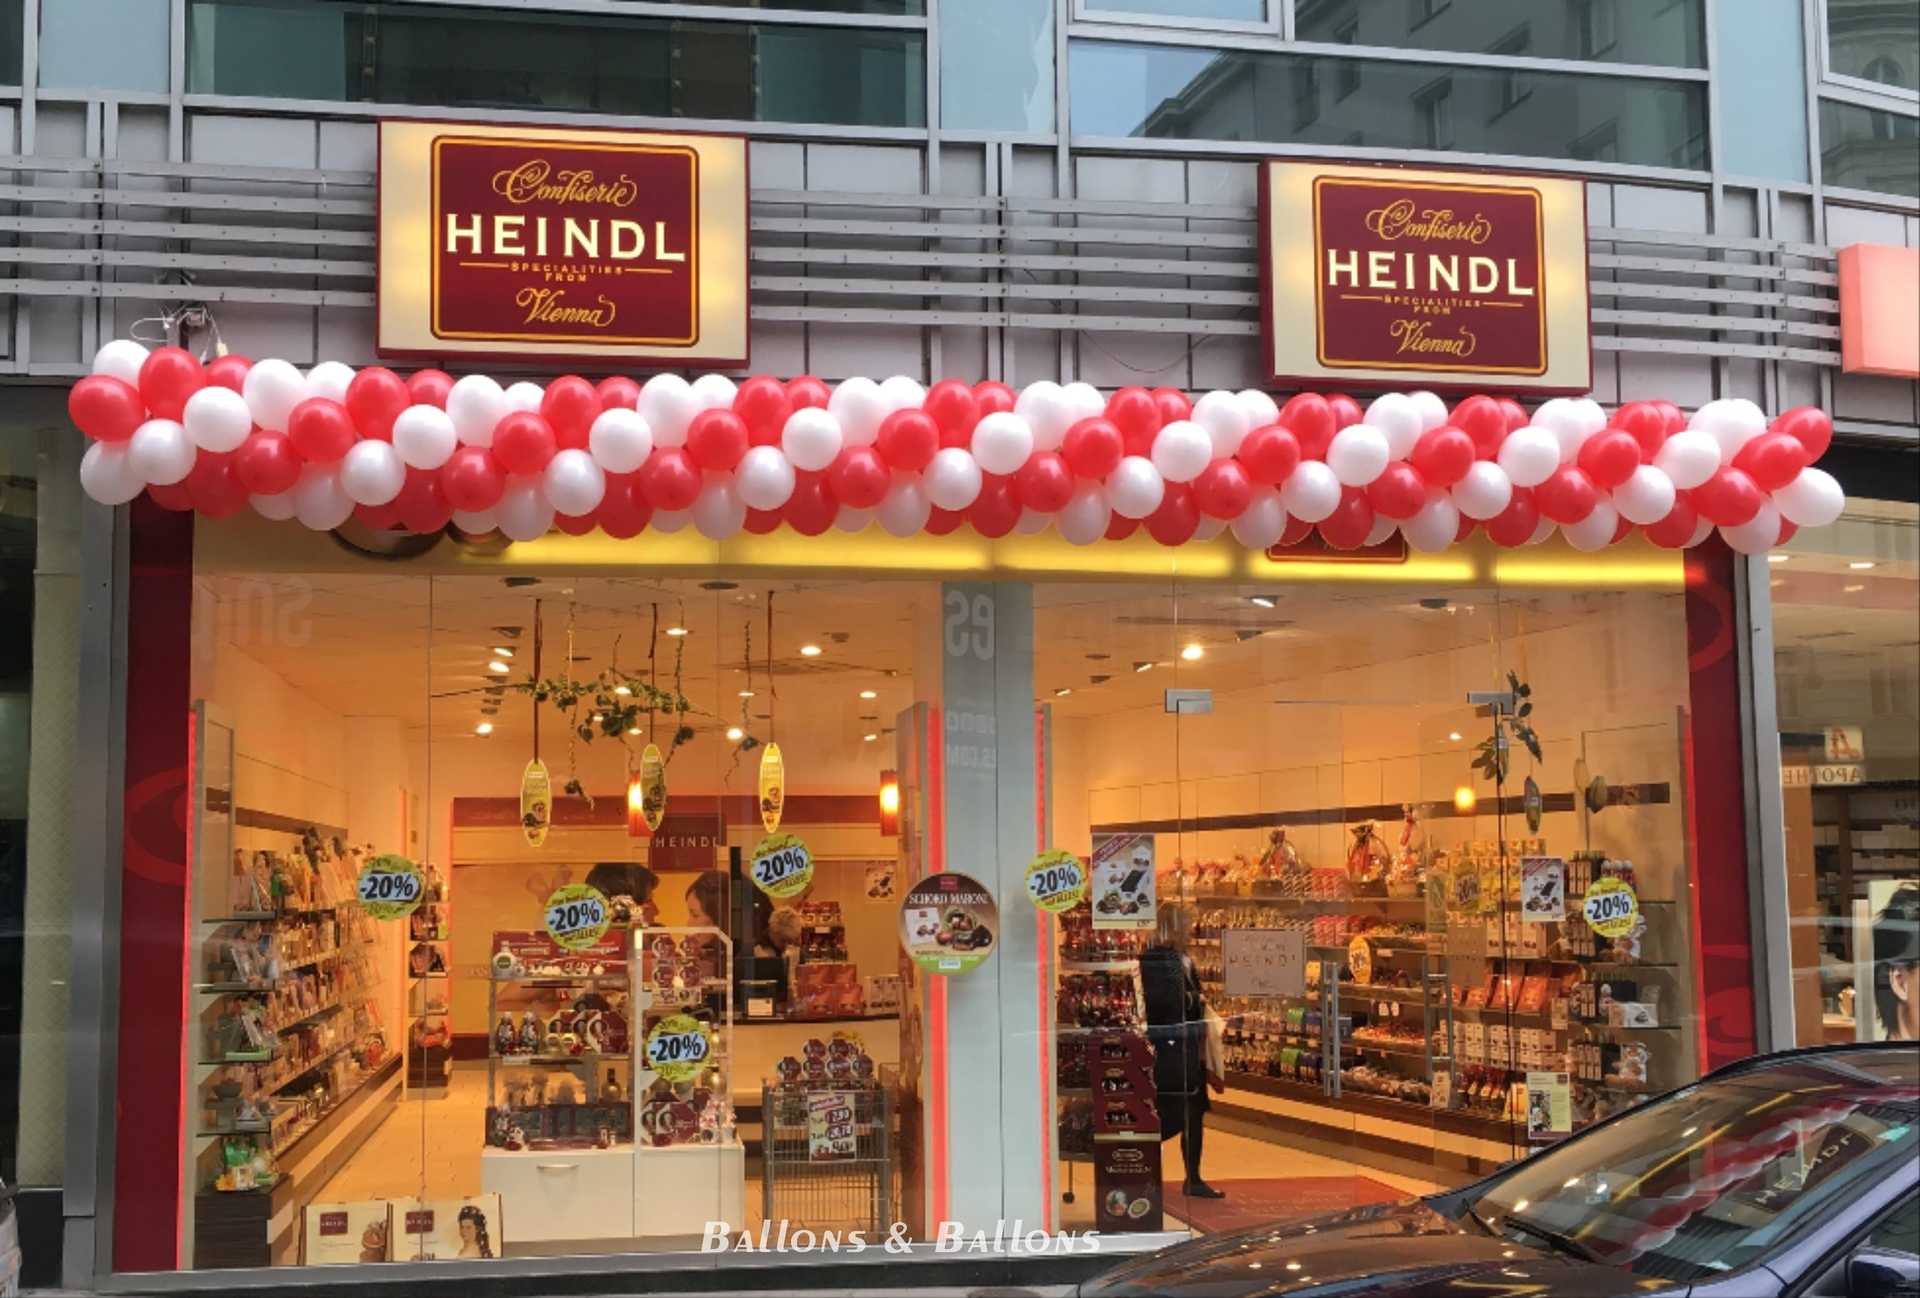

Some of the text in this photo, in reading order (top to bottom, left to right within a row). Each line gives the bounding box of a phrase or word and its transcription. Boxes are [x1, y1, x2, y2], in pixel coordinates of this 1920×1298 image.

[493, 159, 638, 207] Confiserie
[1365, 198, 1492, 244] Confiserie
[446, 213, 686, 262] HEINDL
[511, 262, 623, 275] SPECIALITIES
[545, 272, 587, 282] FROM
[1328, 249, 1535, 295] HEINDL
[516, 287, 616, 327] Vienna
[1384, 295, 1481, 308] SPECIALITIES
[1414, 305, 1450, 314] FROM
[1390, 319, 1476, 357] Vienna
[655, 836, 720, 848] HEINDL
[756, 848, 804, 882] -20%
[1030, 864, 1077, 896] -20%
[360, 874, 413, 899] -20%
[549, 900, 600, 931] -20%
[1587, 893, 1630, 919] -20%
[650, 1033, 702, 1061] -20%
